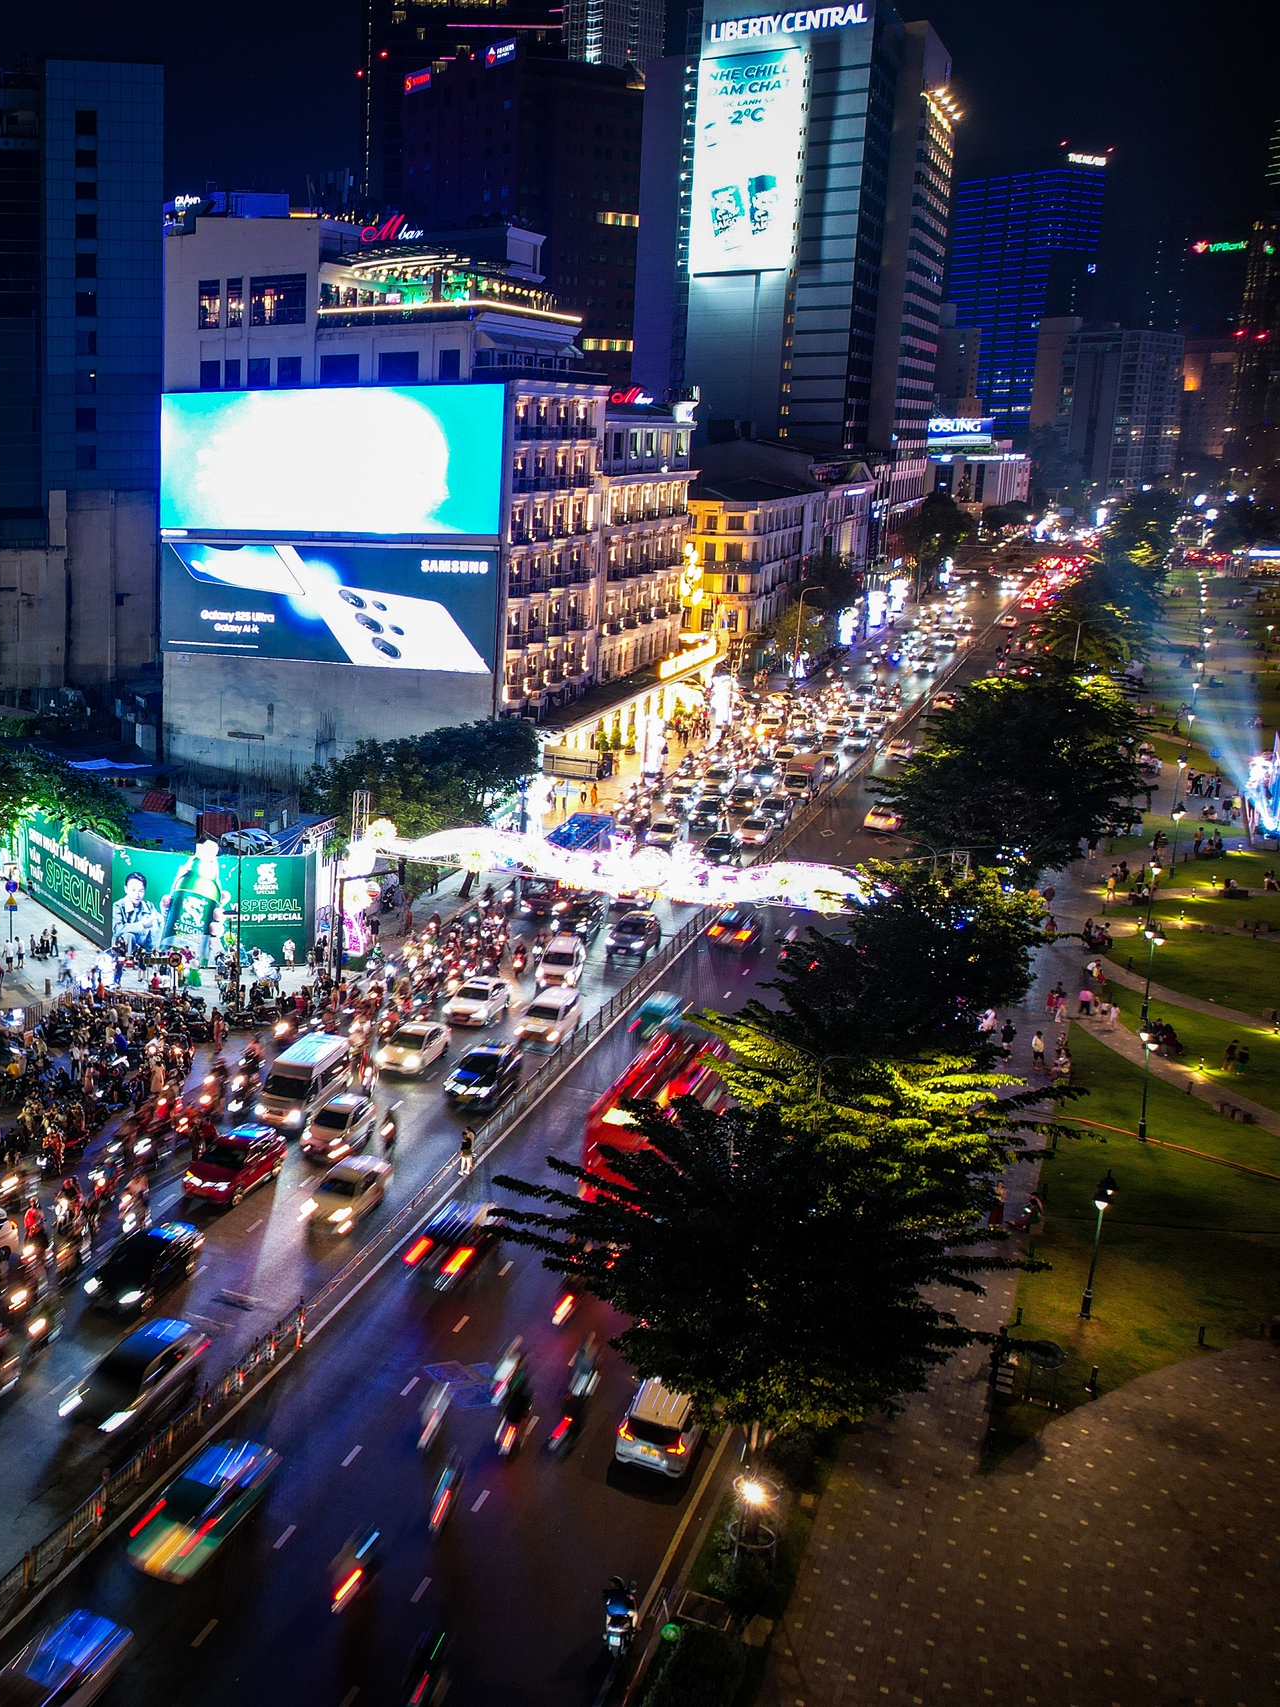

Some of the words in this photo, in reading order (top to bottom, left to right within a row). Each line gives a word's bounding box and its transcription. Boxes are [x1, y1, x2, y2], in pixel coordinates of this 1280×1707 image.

[710, 14, 781, 43] LIBERTY
[781, 3, 868, 34] CENTRAL
[1209, 239, 1247, 252] VPBank
[420, 559, 489, 574] SAMSUNG
[200, 609, 234, 623] Galaxy
[251, 611, 275, 623] Ultra
[214, 623, 242, 634] Galaxy
[45, 858, 105, 924] SPECIAL
[241, 899, 302, 912] SPECIAL
[267, 912, 303, 921] SPECIAL
